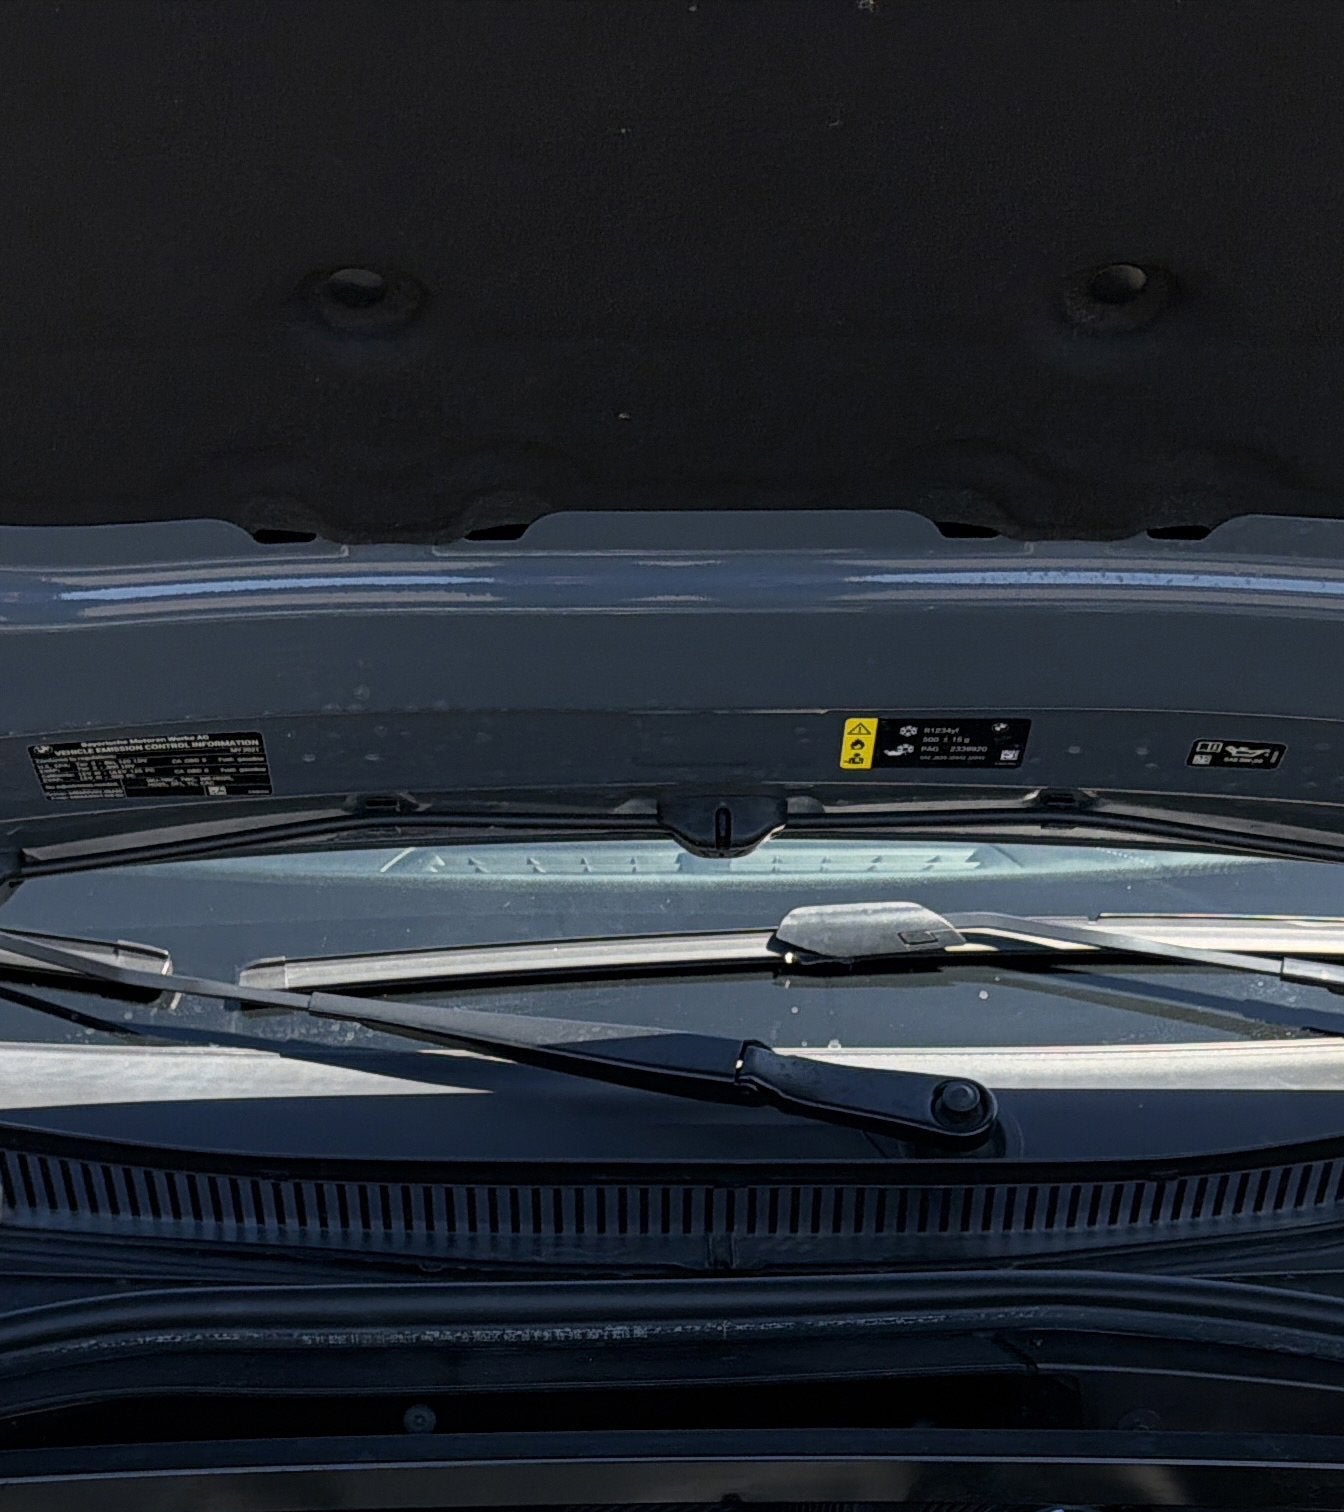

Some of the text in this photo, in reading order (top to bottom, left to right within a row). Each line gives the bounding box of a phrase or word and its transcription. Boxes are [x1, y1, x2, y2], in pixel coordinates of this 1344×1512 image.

[53, 738, 260, 757] VEHICLE EMISSION CONTROL INFORMATION
